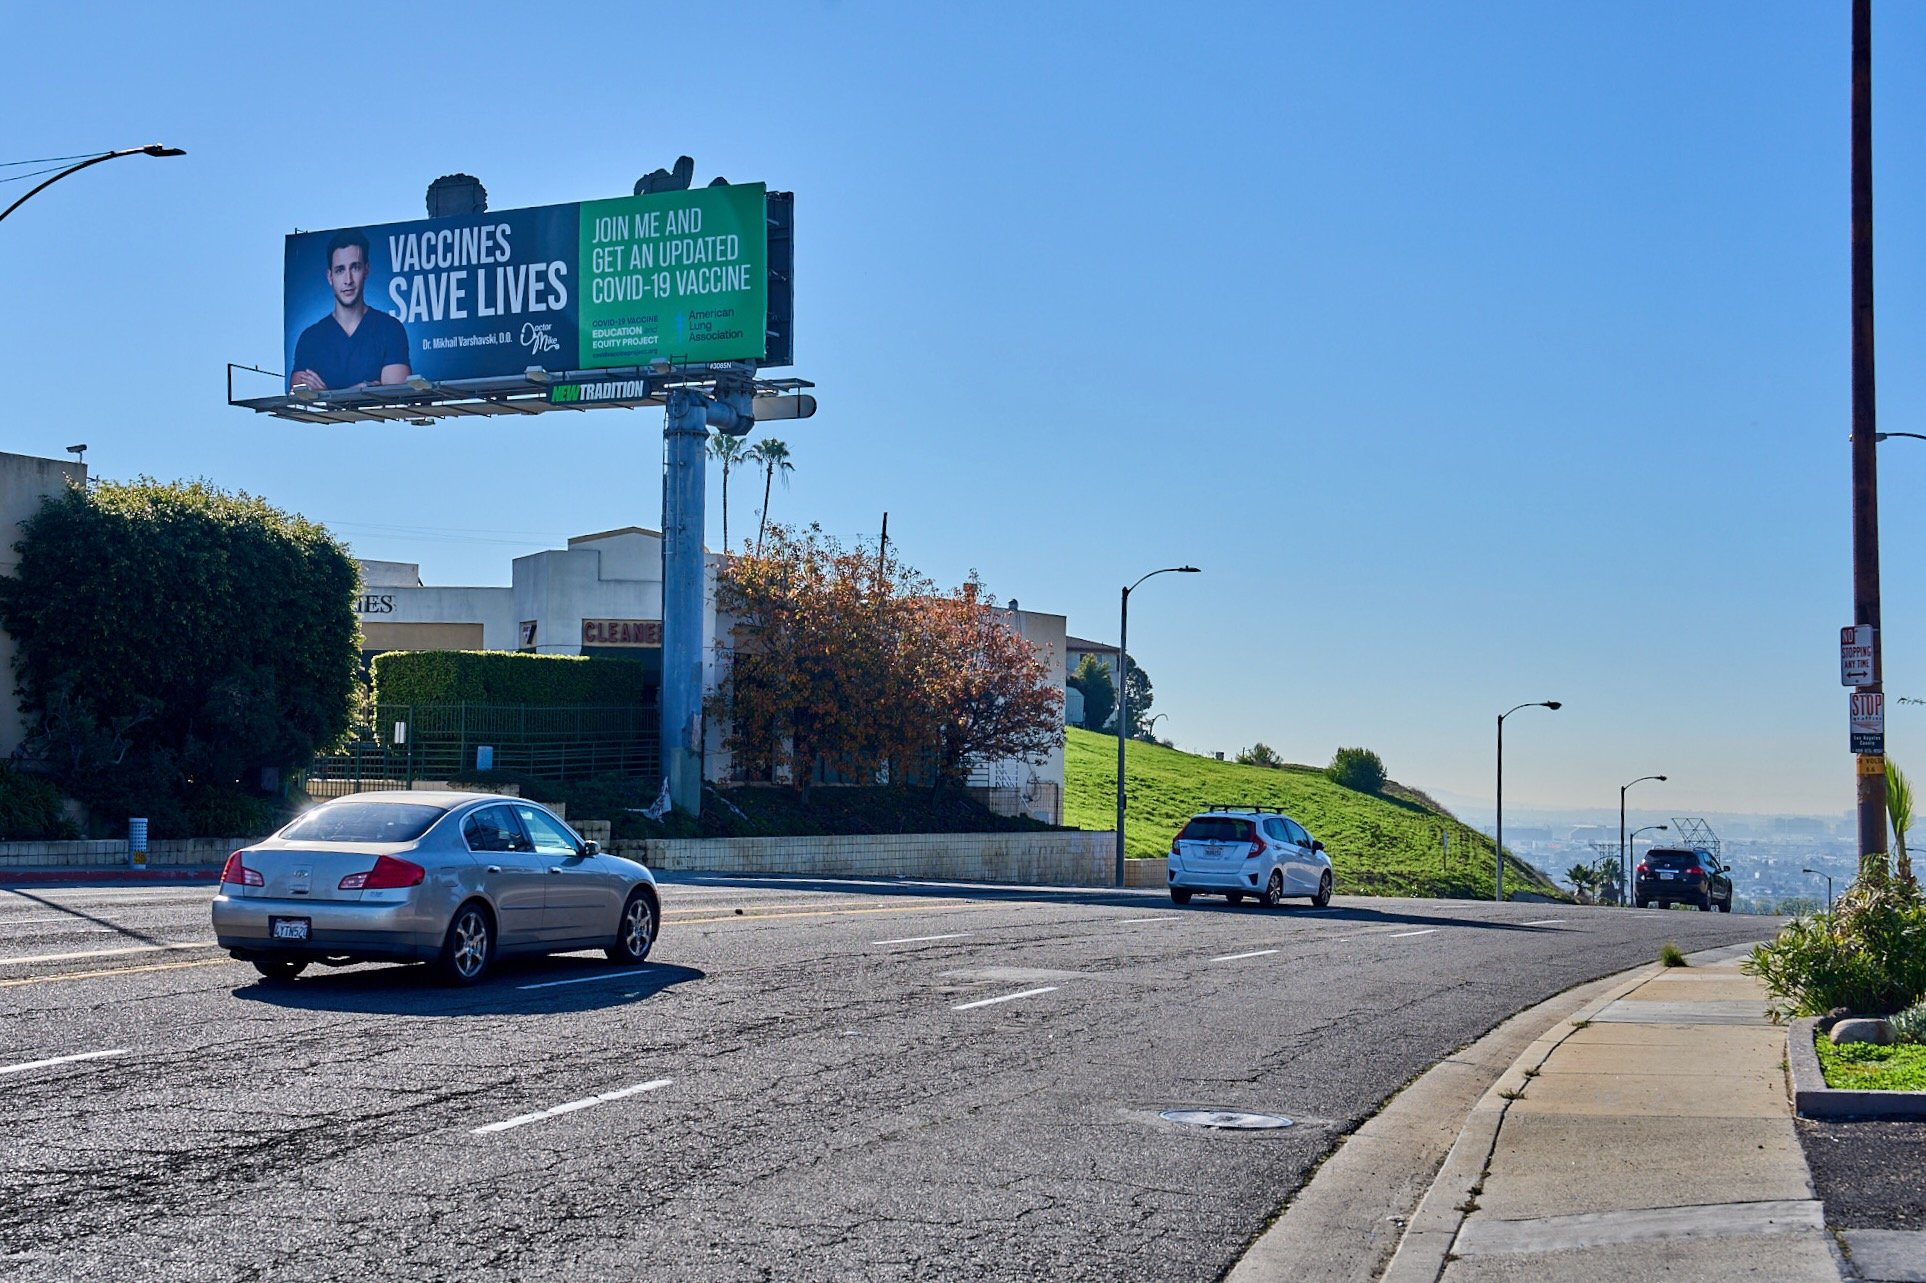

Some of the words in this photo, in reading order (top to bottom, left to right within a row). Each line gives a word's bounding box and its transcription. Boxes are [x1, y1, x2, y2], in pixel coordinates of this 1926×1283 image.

[592, 215, 629, 243] JOIN
[635, 212, 660, 239] ME
[665, 208, 702, 236] AND
[389, 223, 511, 273] VACCINES
[592, 246, 625, 274] GET
[629, 243, 653, 270] AN
[659, 235, 739, 267] UPDATED
[388, 270, 468, 324] SAVE
[477, 260, 568, 317] LIVES
[592, 272, 671, 304] COVID-19
[675, 264, 751, 296] VACCINE
[592, 317, 626, 327] COVID-19
[627, 315, 658, 324] VACCINE
[688, 308, 734, 320] American
[520, 322, 552, 346] Doctor
[592, 326, 642, 338] EDUCATION
[689, 321, 712, 332] Lung
[422, 339, 432, 350] Dr.
[433, 336, 457, 349] Mikhail
[458, 333, 498, 348] Varshavski,
[498, 331, 513, 344] D.O.
[532, 331, 560, 355] Mike
[592, 339, 621, 349] EQUITY
[622, 336, 659, 346] PROJECT
[688, 330, 743, 341] Association
[1842, 629, 1854, 643] NO
[1842, 645, 1872, 657] STOPPING
[1844, 660, 1855, 668] ANY
[1857, 659, 1869, 668] TIME
[1852, 694, 1882, 716] STOP
